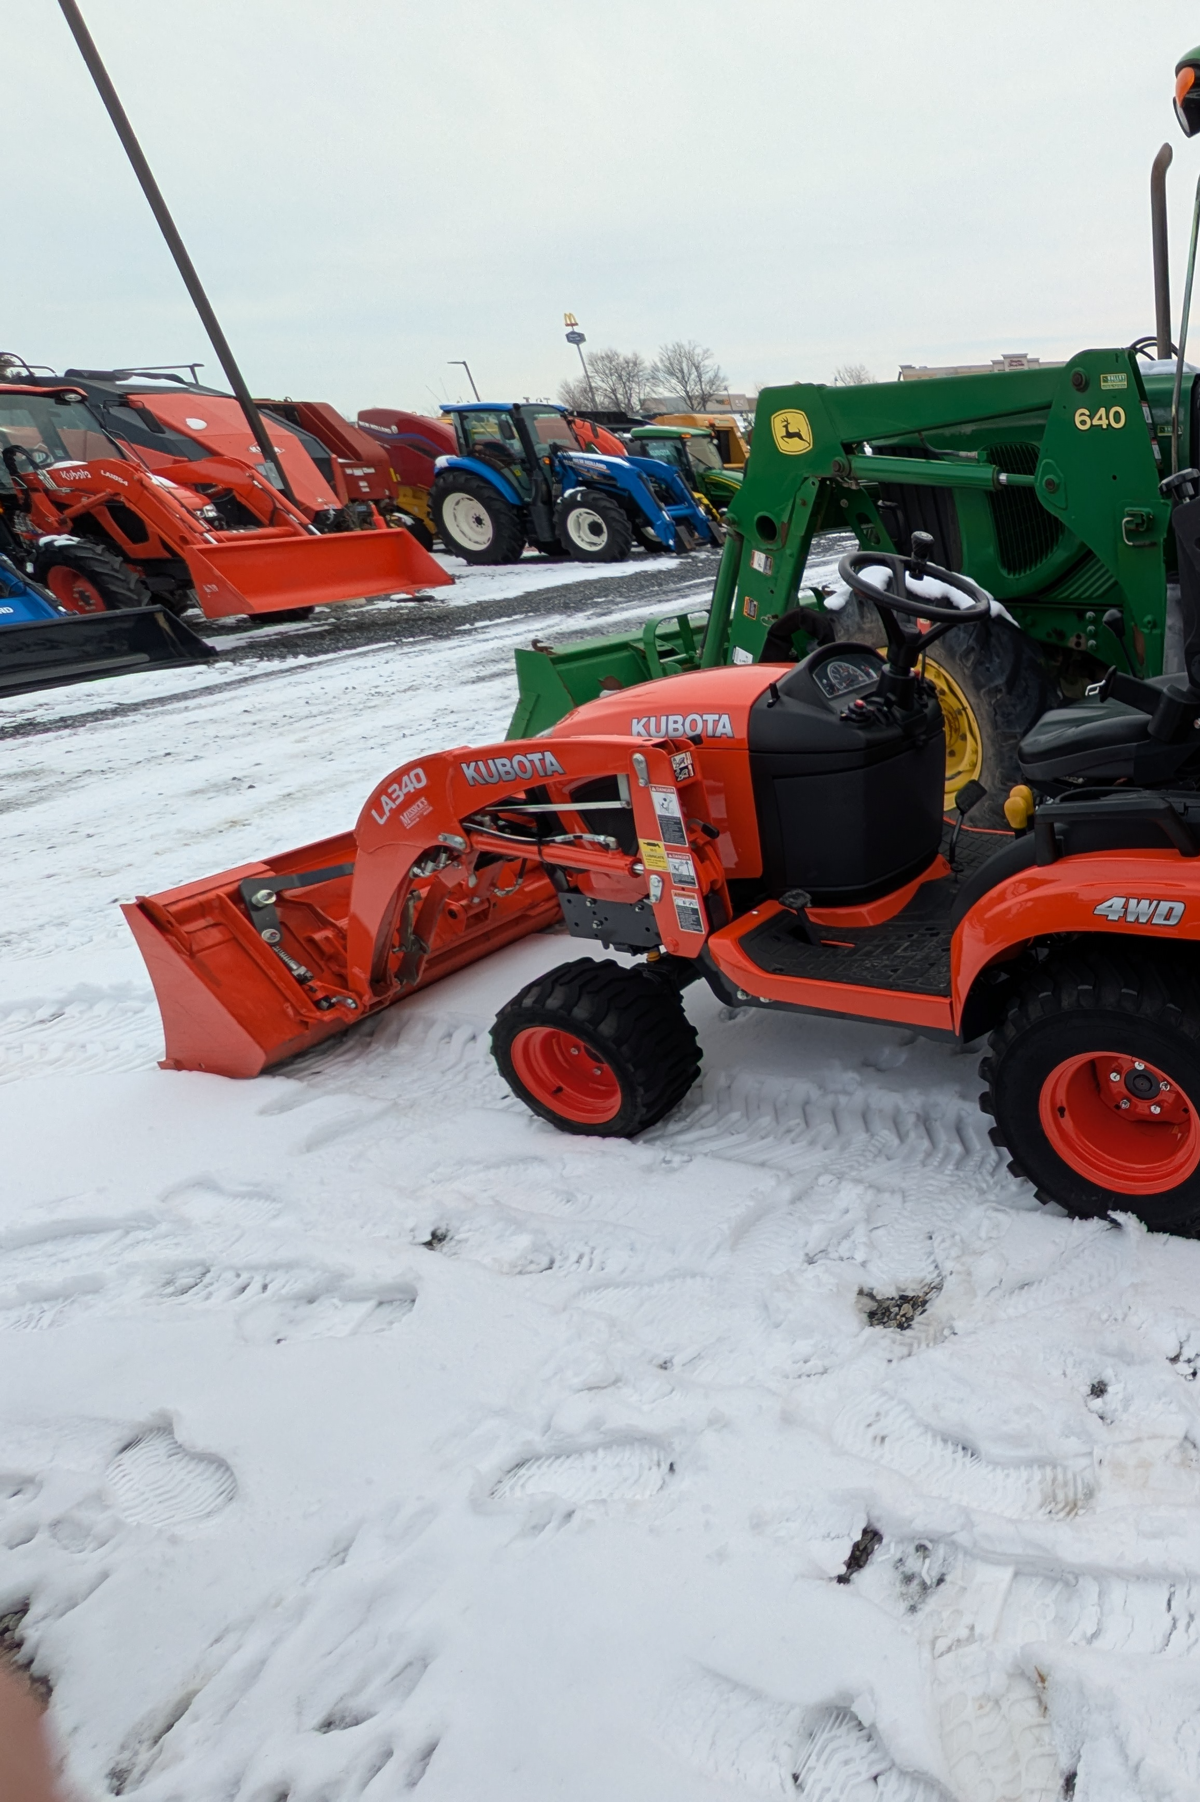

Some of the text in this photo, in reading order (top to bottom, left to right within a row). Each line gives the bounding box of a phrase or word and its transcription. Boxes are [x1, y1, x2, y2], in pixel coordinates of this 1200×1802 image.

[1074, 406, 1126, 431] 640
[60, 468, 92, 480] Kubota
[631, 713, 735, 739] KUBOTA
[460, 751, 567, 787] KUBOTA
[371, 767, 428, 825] LA340
[655, 786, 675, 794] DANGER
[1093, 895, 1187, 927] 4WD
